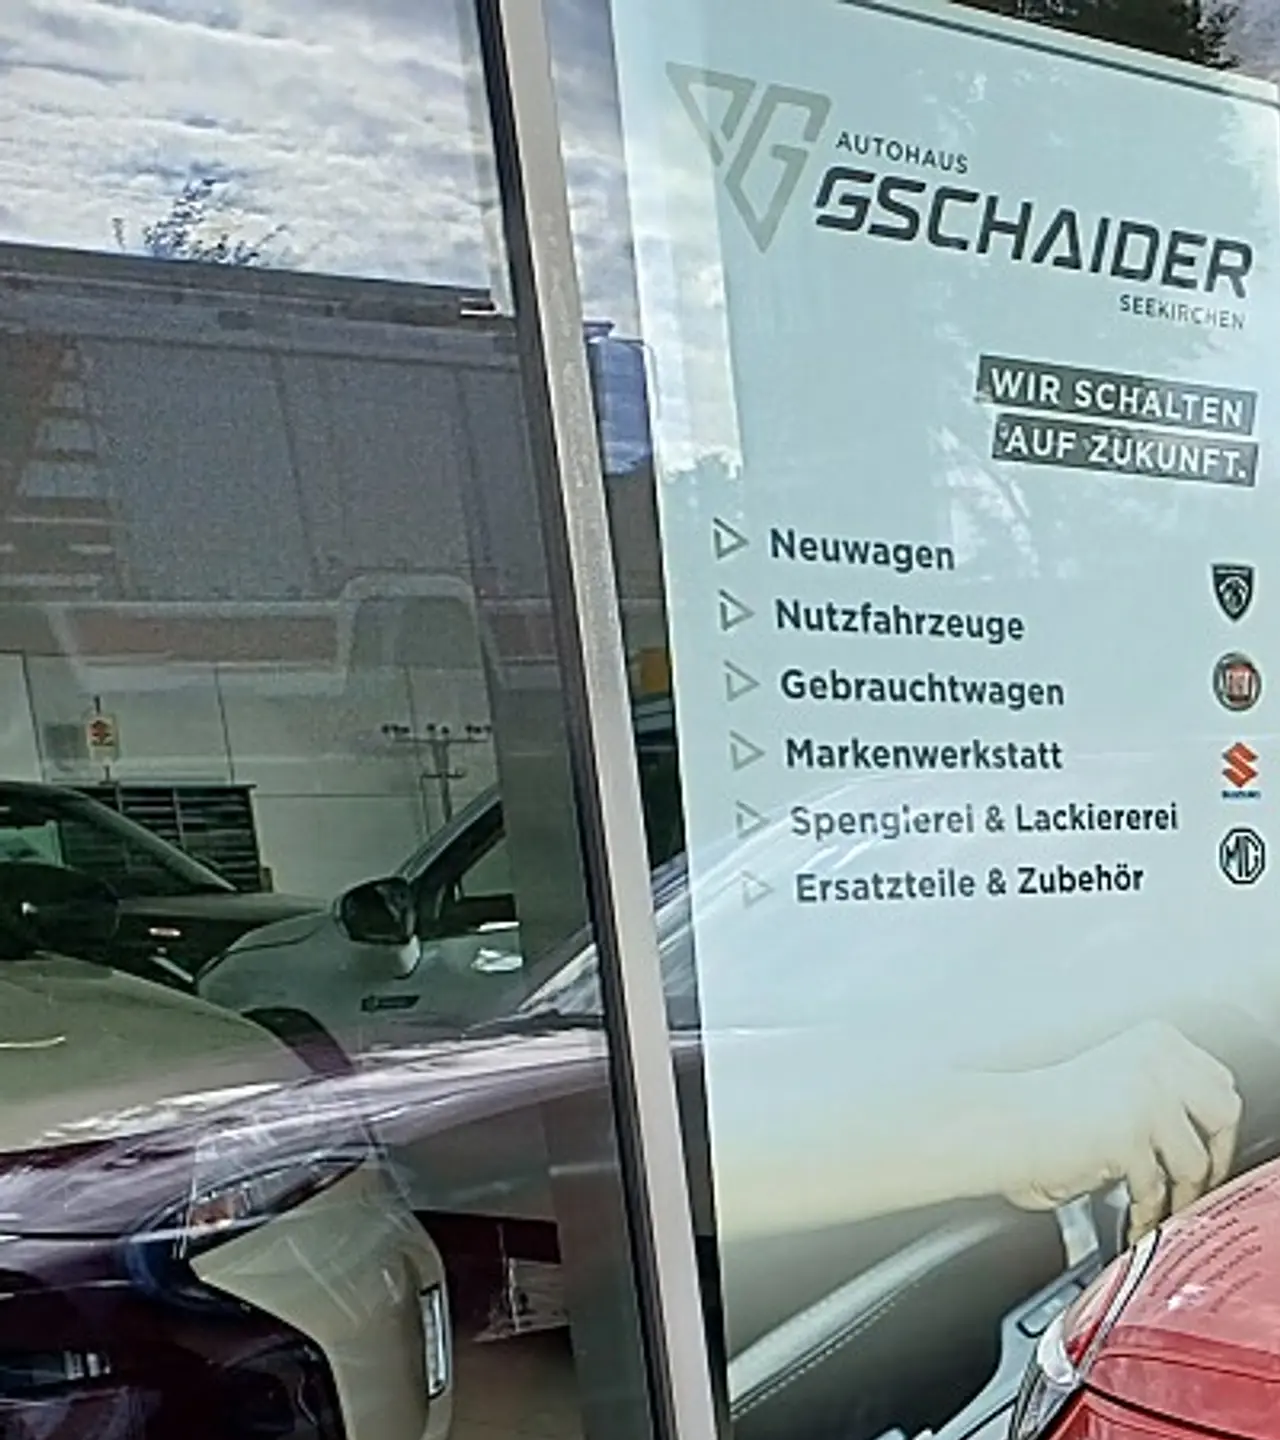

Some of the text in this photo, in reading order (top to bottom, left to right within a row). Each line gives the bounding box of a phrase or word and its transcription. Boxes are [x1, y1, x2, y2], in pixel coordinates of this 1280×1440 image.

[836, 130, 969, 175] AUTOHAUS
[814, 165, 1254, 298] GSCHAIDER
[1120, 294, 1246, 331] SEEKIRCHEN
[991, 366, 1244, 429] WIR SCHALTEN
[1005, 425, 1247, 481] AUF ZUKUNFT.
[769, 527, 956, 575] Neuwagen
[775, 598, 1026, 645] Nutzfahrzeuge
[780, 668, 1065, 711] Gebrauchtwagen
[785, 738, 1064, 770] Markenwerkstatt
[790, 801, 1180, 842] Spenglerei & Lackiererei
[795, 862, 1145, 903] Ersatzteile & Zubehör
